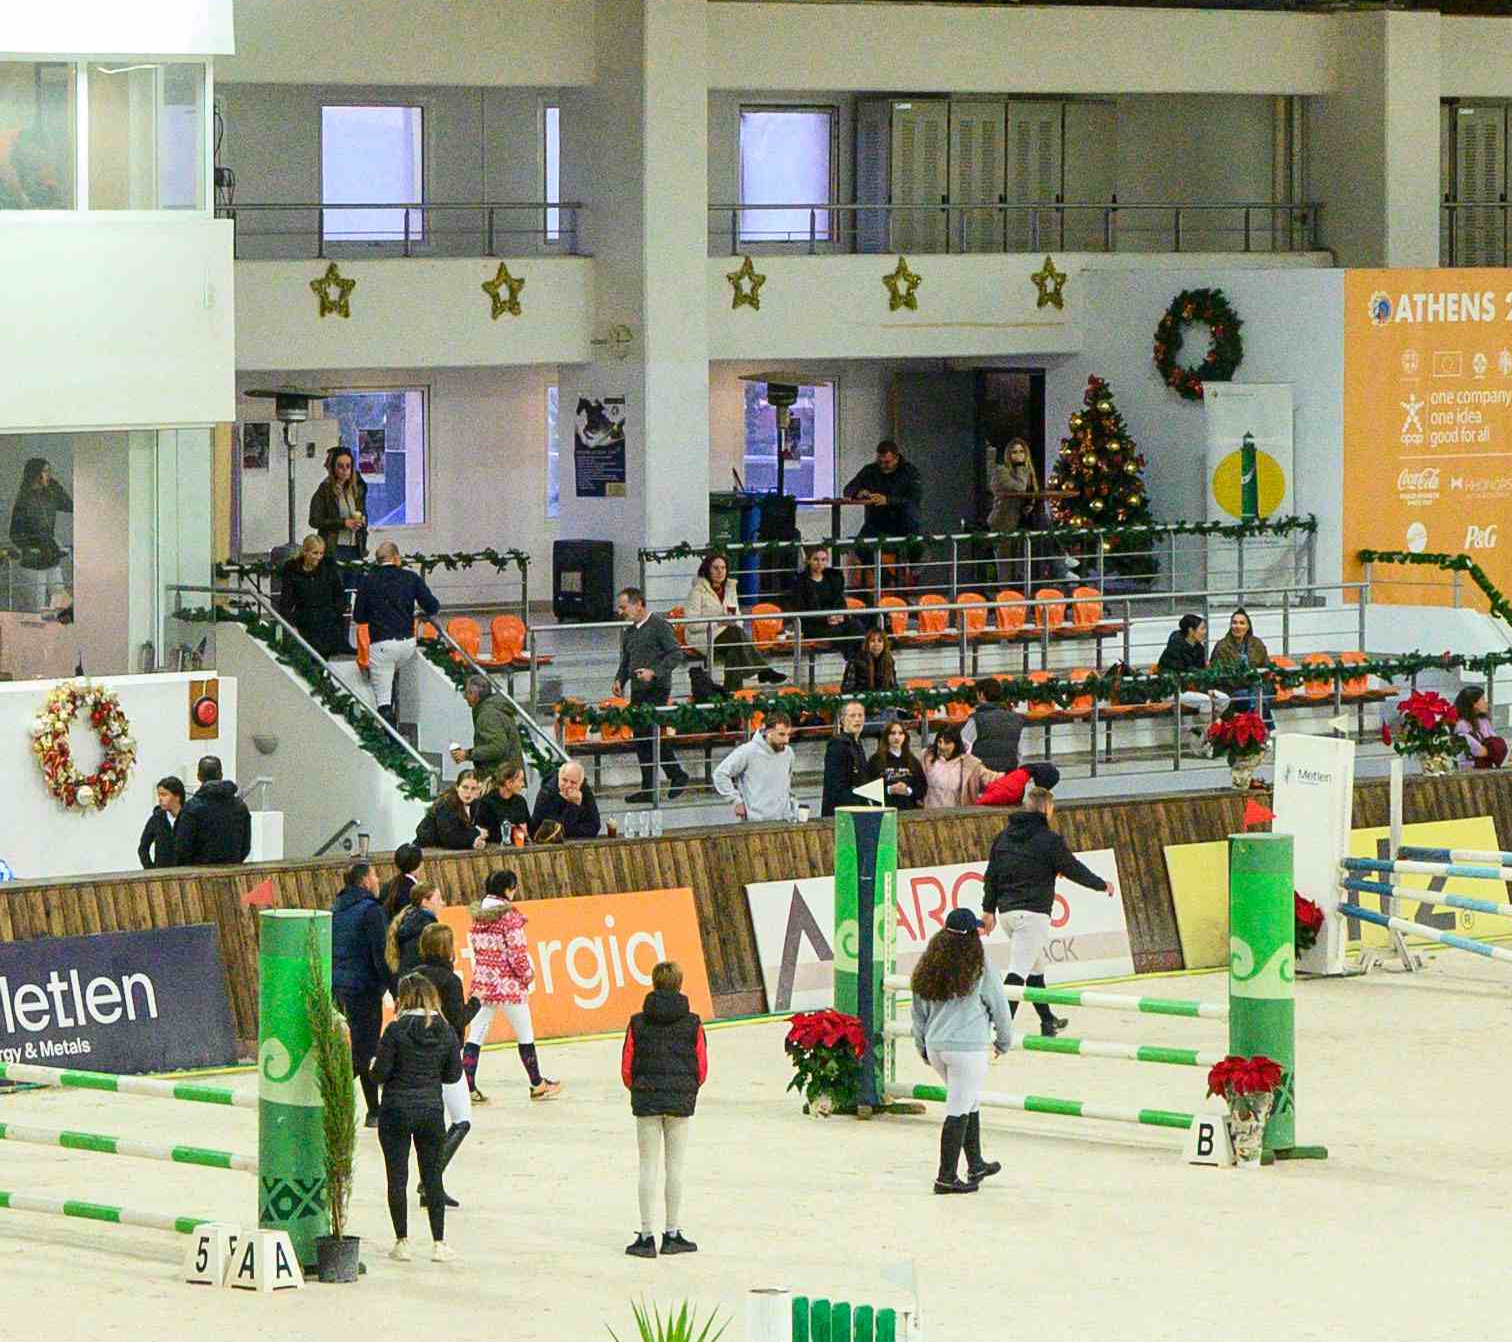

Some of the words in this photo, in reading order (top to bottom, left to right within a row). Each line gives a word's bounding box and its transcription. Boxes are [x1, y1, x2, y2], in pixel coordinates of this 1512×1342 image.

[1395, 291, 1496, 324] ATHENS
[1430, 391, 1454, 405] one
[1456, 389, 1512, 408] company
[1430, 411, 1454, 425] one
[1456, 408, 1482, 424] idea
[1430, 426, 1459, 448] good
[1460, 425, 1476, 443] for
[1478, 426, 1489, 442] all
[1463, 524, 1498, 550] P&G
[1297, 768, 1332, 784] Metlen
[25, 1041, 39, 1059] &
[40, 1036, 92, 1058] Metals
[1197, 1123, 1214, 1156] B
[195, 1236, 210, 1274] 5
[237, 1241, 255, 1280] A
[276, 1241, 293, 1279] A
